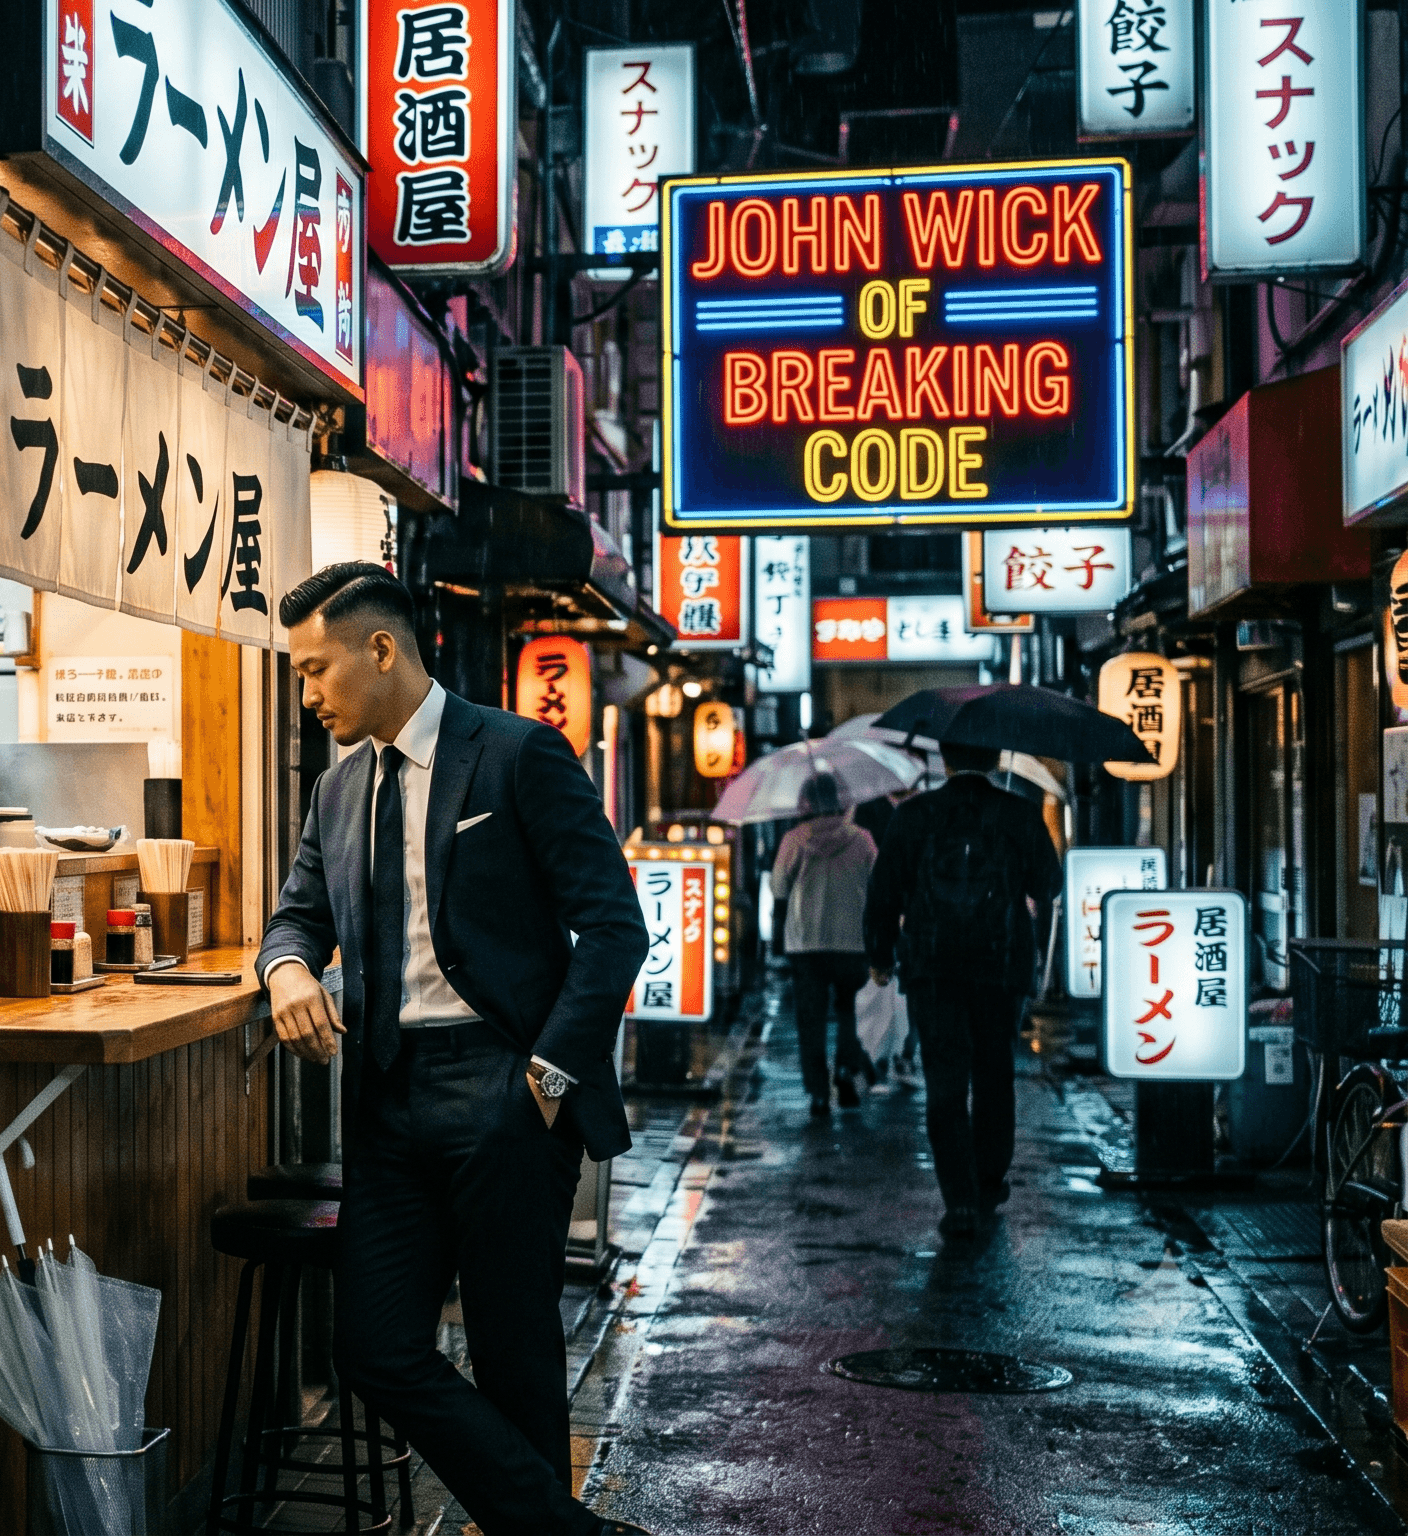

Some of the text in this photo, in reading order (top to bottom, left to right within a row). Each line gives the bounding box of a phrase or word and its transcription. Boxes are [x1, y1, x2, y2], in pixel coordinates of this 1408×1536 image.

[1105, 0, 1171, 118] 餃子
[109, 0, 325, 334] ラーメン屋
[396, 6, 469, 243] 居酒屋
[620, 61, 659, 213] スナック
[1256, 17, 1315, 246] スナック
[692, 183, 1103, 279] JOHN WICK
[858, 277, 931, 340] OF
[724, 341, 1071, 425] BREAKING
[10, 362, 269, 616] ラーメン屋
[803, 425, 989, 503] CODE
[1001, 545, 1115, 591] 餃子
[644, 871, 673, 1009] ラーメン屋
[1132, 909, 1177, 1065] ラーメン
[1194, 906, 1228, 1008] 居酒屋
